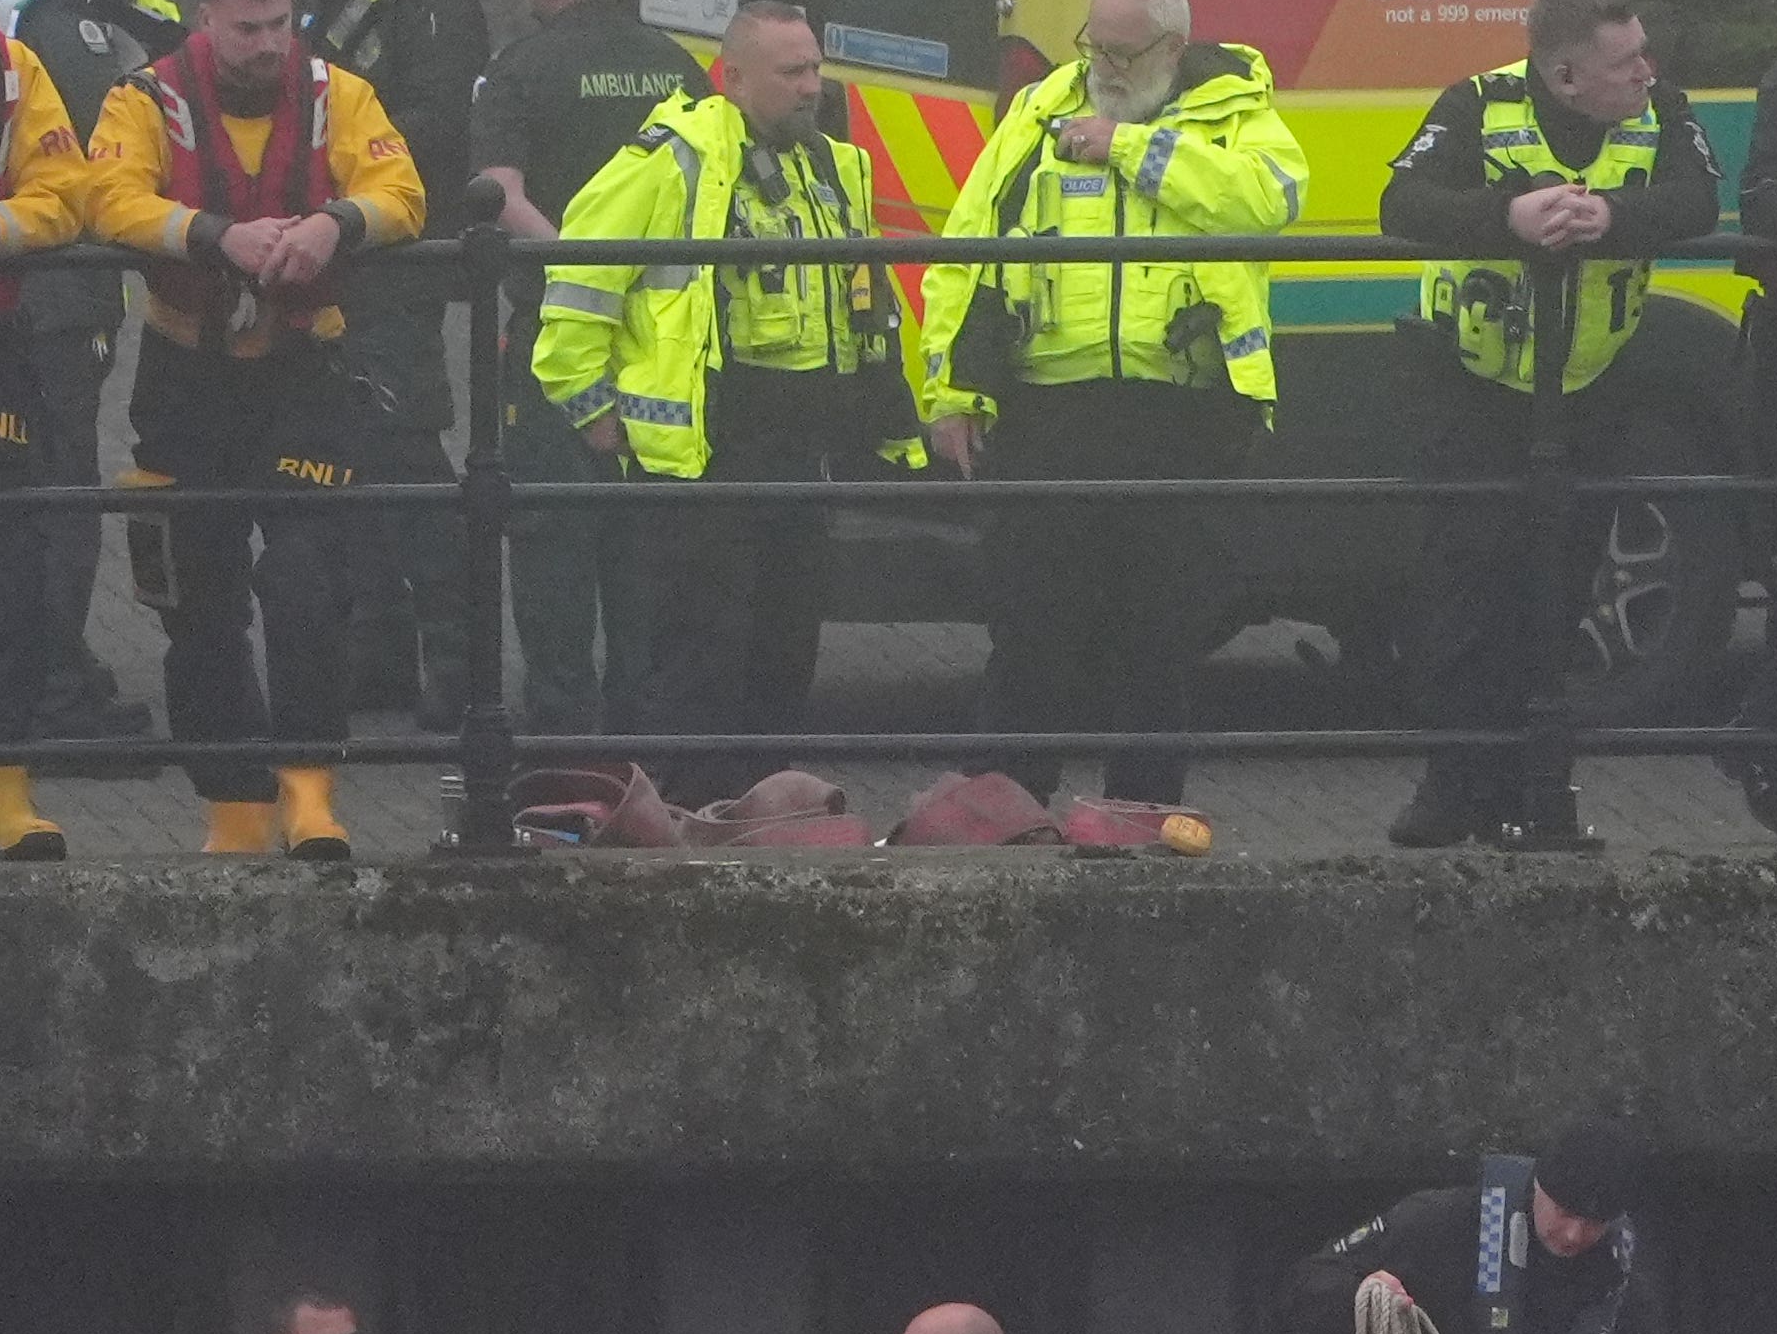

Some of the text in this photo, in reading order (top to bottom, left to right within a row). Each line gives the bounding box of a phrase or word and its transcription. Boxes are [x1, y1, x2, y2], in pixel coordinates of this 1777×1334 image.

[1385, 5, 1529, 27] not a 999 emerg
[1062, 176, 1105, 194] OLICE
